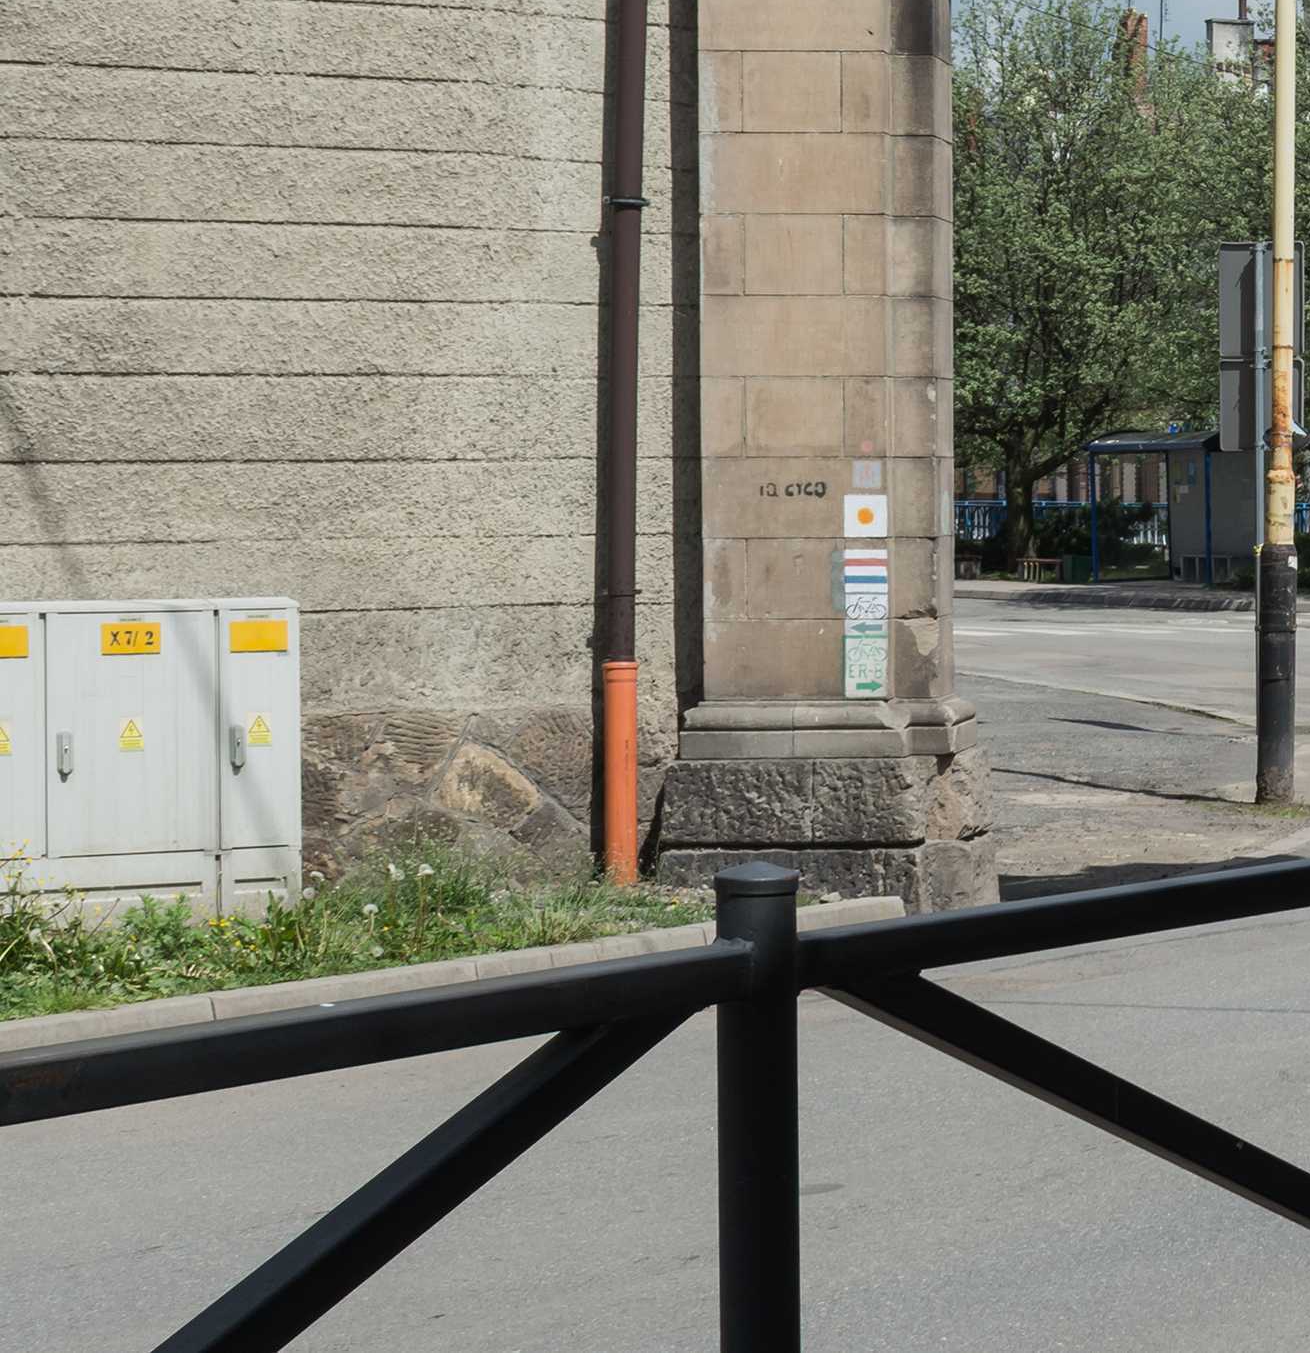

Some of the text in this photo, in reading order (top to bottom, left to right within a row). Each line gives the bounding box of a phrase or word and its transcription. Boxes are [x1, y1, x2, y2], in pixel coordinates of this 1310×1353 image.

[110, 631, 121, 646] X
[144, 631, 154, 646] 2
[849, 663, 883, 678] ER-8
